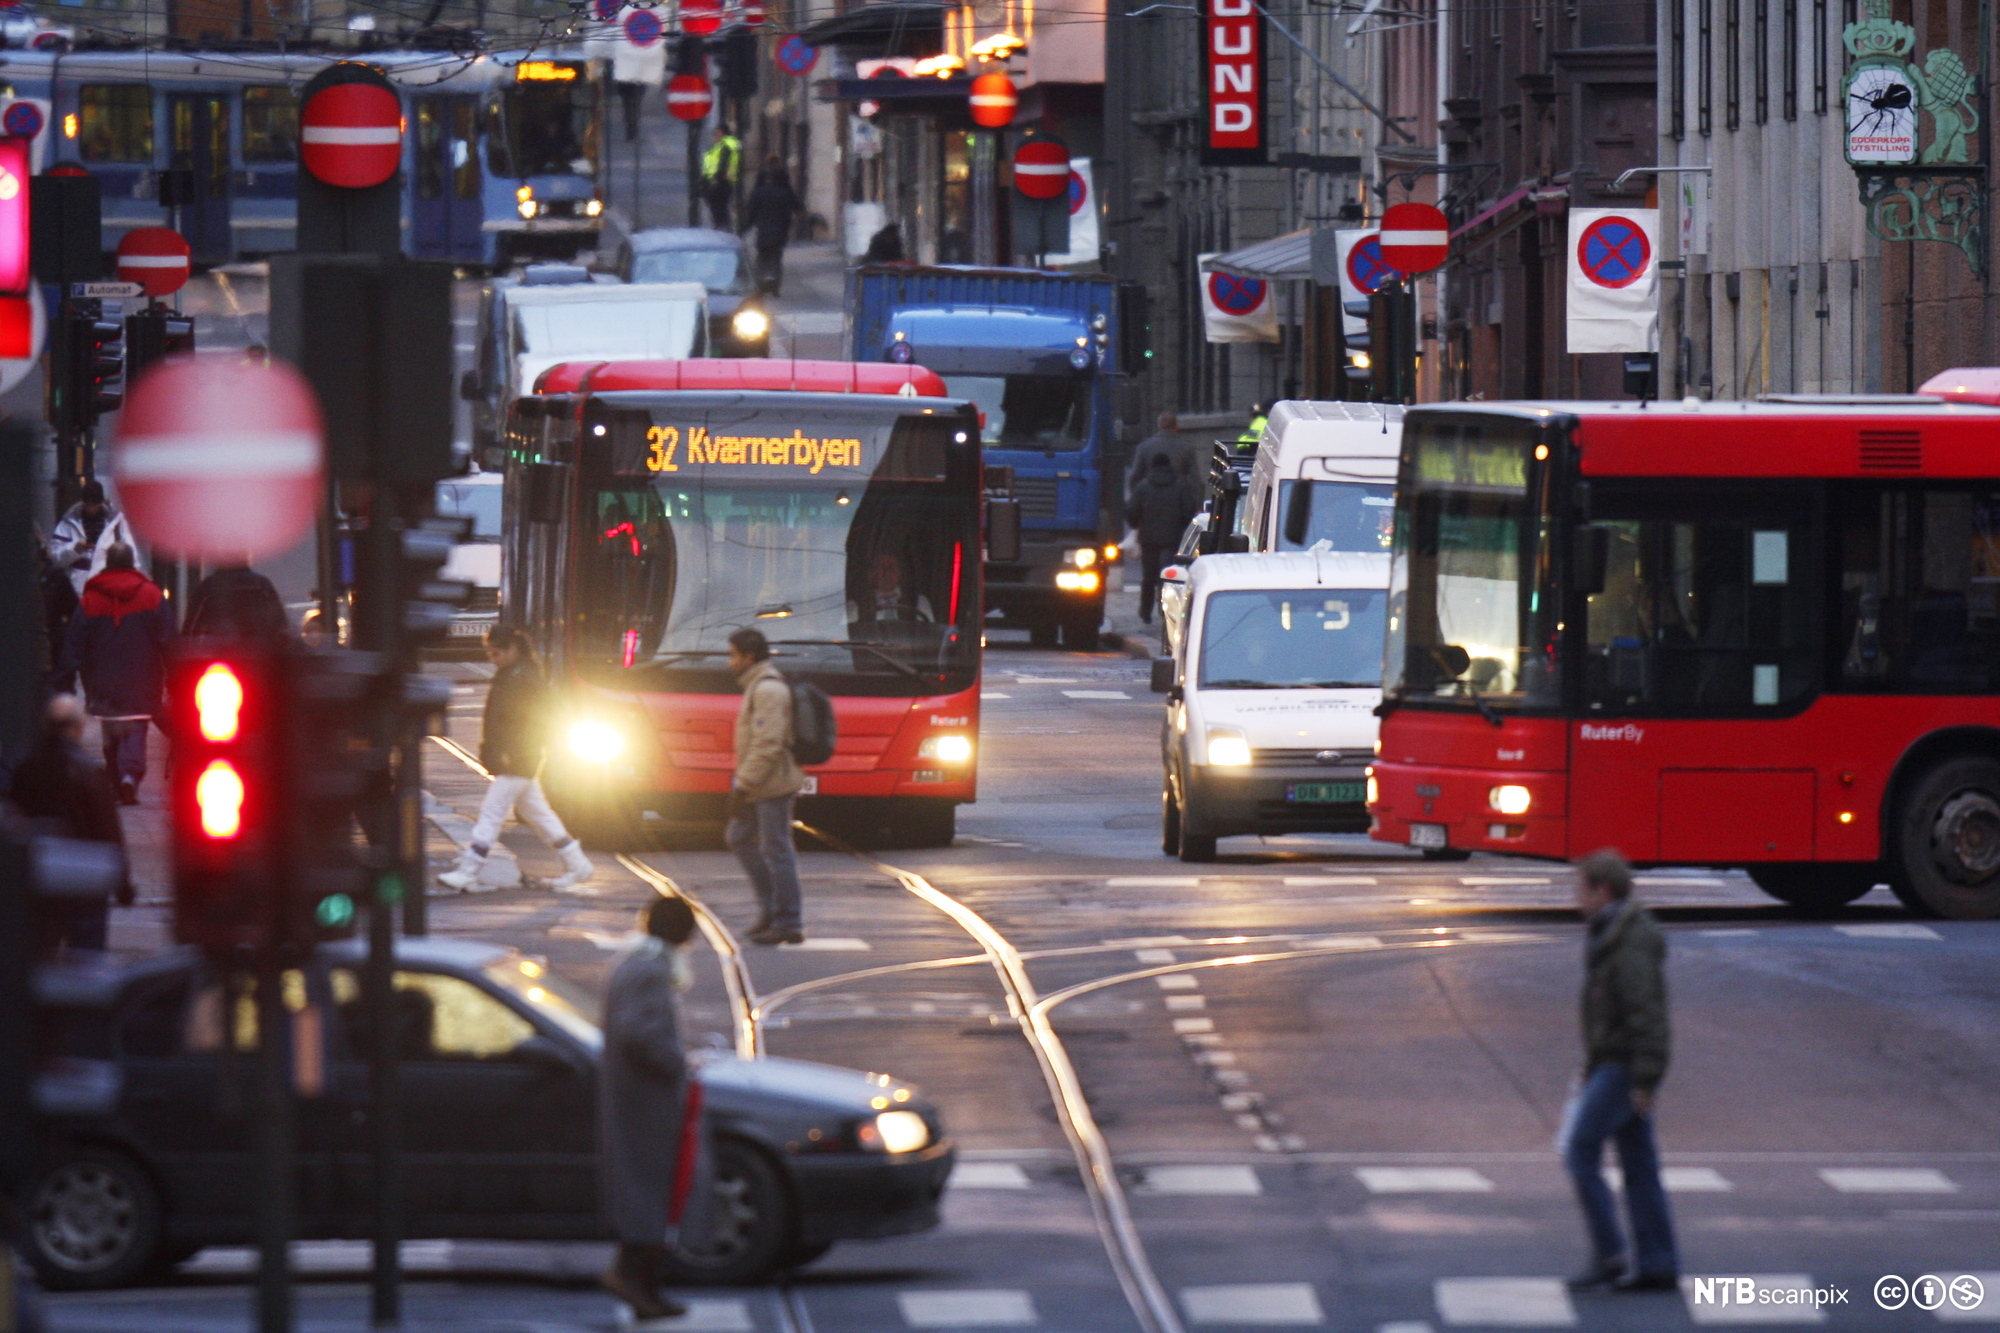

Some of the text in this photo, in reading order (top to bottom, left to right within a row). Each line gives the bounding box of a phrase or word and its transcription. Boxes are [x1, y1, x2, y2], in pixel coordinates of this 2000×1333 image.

[88, 285, 132, 295] Automat
[646, 426, 862, 475] 32 Kværnerbyen
[1580, 723, 1645, 745] RuterBy
